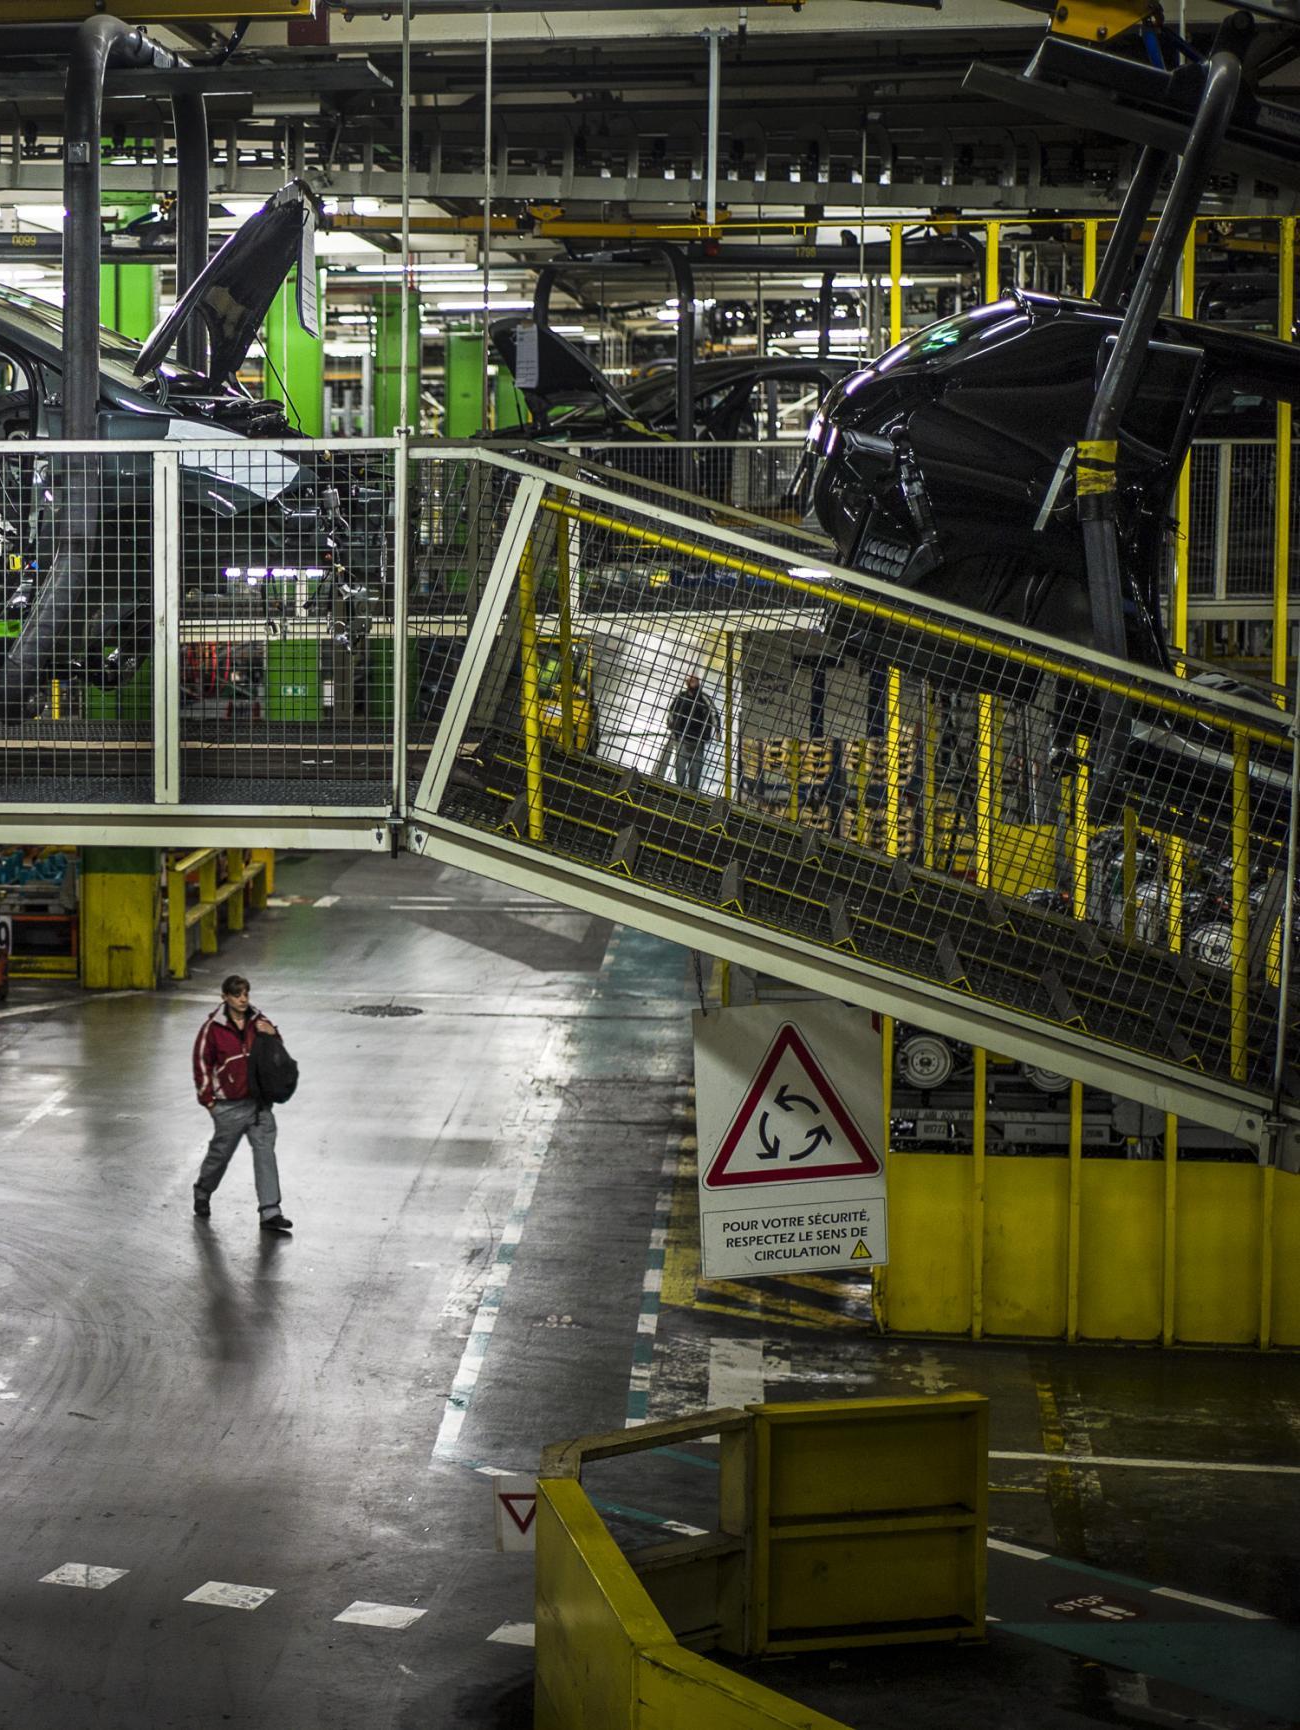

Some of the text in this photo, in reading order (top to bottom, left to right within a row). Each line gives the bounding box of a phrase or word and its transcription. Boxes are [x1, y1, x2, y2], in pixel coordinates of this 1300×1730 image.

[12, 234, 37, 248] 0099
[722, 1210, 870, 1233] POUR VOTRE SÉCURITÉ,
[726, 1226, 869, 1248] RESPECTEZ LE SENS DE
[754, 1244, 842, 1261] CIRCULATION
[1053, 1594, 1105, 1612] STOP
